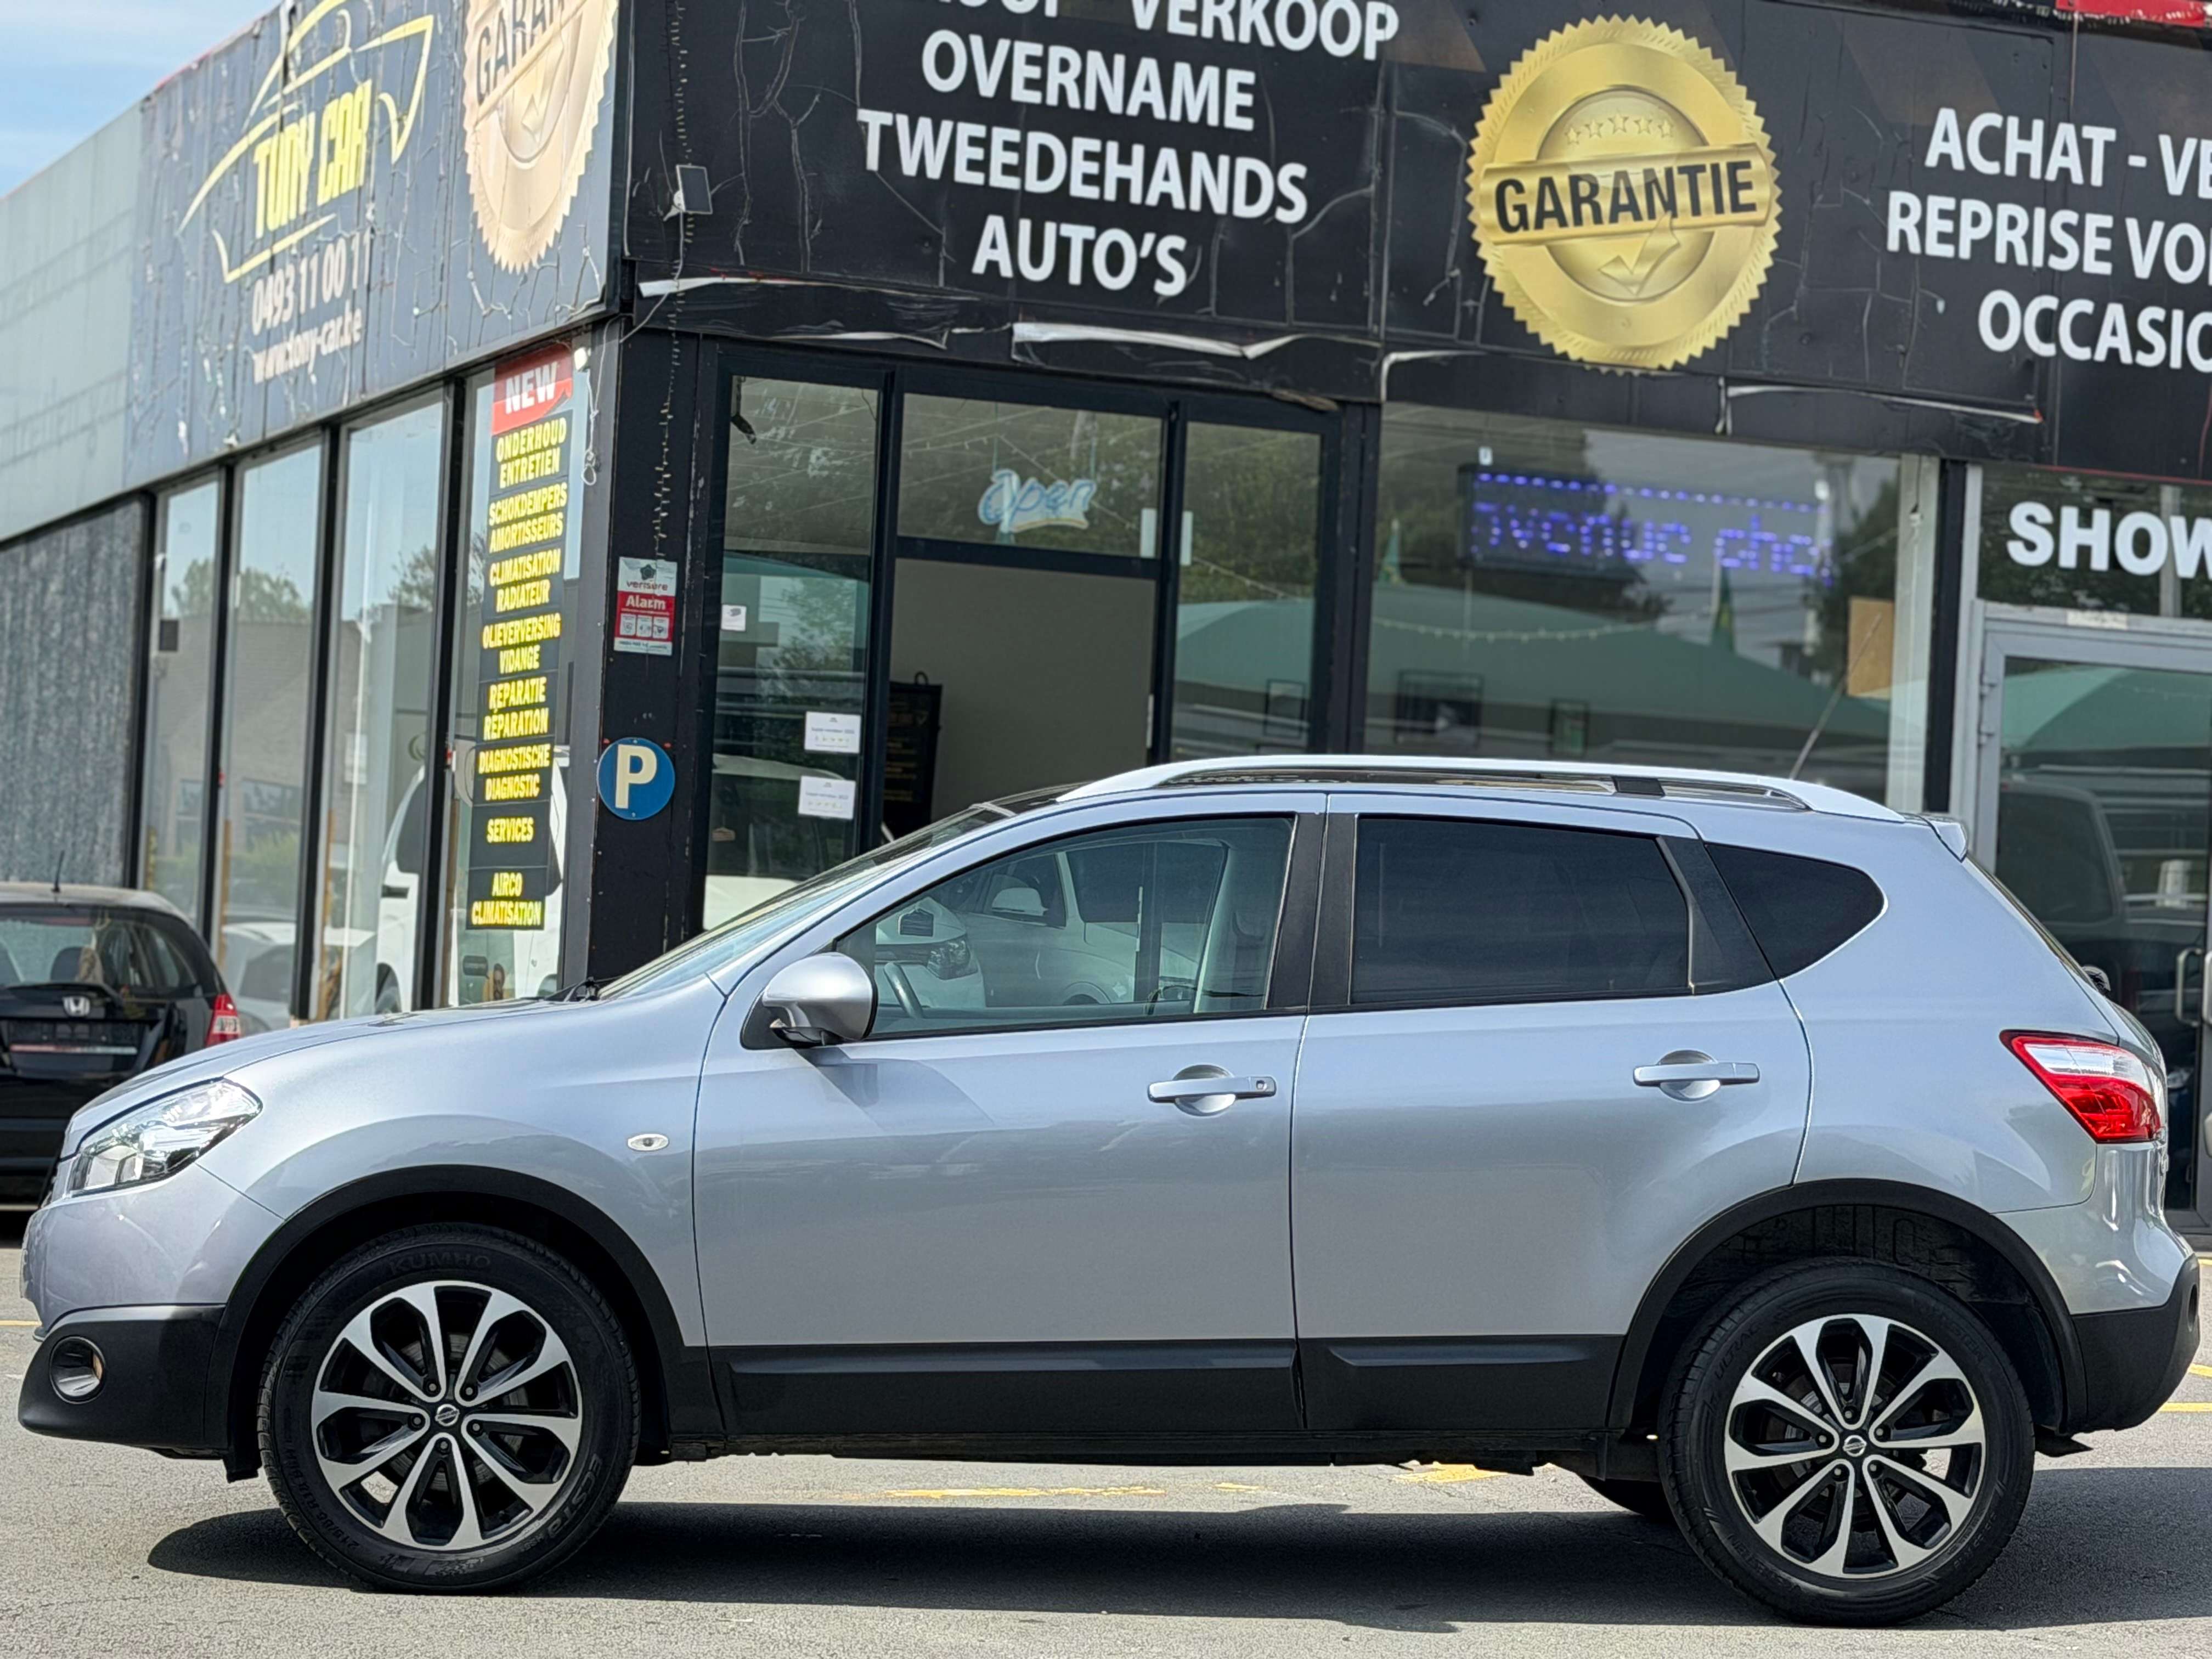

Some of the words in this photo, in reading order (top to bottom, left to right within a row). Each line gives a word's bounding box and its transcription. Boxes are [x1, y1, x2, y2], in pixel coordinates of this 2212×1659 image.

[922, 29, 1255, 131] OVERNAME
[317, 78, 372, 206] CAR
[1925, 108, 2116, 187] ACHAT
[857, 109, 1307, 223] TWEEDEHANDS
[1495, 161, 1757, 233] GARANTIE
[972, 215, 1187, 297] AUTO'S
[1887, 190, 2114, 275] REPRISE
[2125, 217, 2212, 286] VO
[252, 266, 296, 336] 0493
[300, 253, 319, 314] 11
[323, 238, 347, 303] 00
[351, 227, 371, 290] 11
[505, 362, 559, 414] NEW
[496, 417, 567, 462] ONDERHOUD
[500, 448, 560, 488] ENTRETIEN
[489, 483, 567, 525] SCHOKDEMPERS
[981, 471, 1096, 527] Open
[489, 515, 563, 553] AMORTISSEURS
[2007, 501, 2212, 580] SHOW
[490, 549, 561, 586] CLIMATISATION
[496, 580, 550, 613] RADIATEUR
[625, 595, 666, 611] Alarm
[482, 612, 561, 650] OLIEVERVERSING
[500, 645, 540, 674] VIDANGE
[489, 676, 547, 709] REPARATIE
[483, 707, 549, 741] RÉPARATION
[478, 743, 551, 774] DIAGNOSTISCHE
[616, 744, 657, 809] P
[486, 773, 540, 800] DIAGNOSTIC
[487, 817, 534, 843] SERVICES
[492, 873, 523, 897] AIRCO
[471, 900, 541, 926] CLIMATISATION
